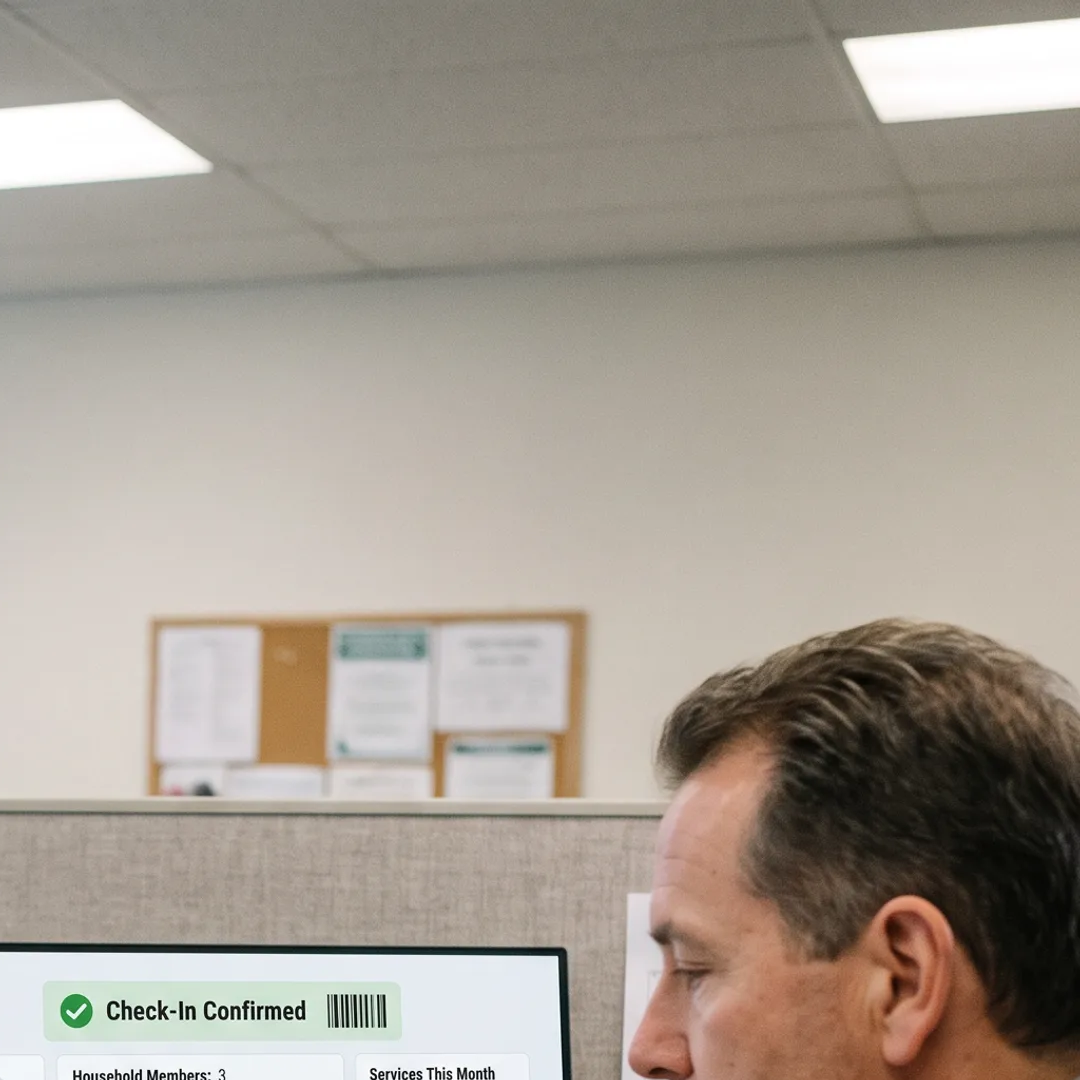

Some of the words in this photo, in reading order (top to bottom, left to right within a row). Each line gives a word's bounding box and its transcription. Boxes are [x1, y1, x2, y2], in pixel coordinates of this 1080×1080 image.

[106, 999, 197, 1021] Check-In
[203, 999, 307, 1021] Confirmed
[425, 1066, 453, 1080] This
[456, 1066, 496, 1080] Month
